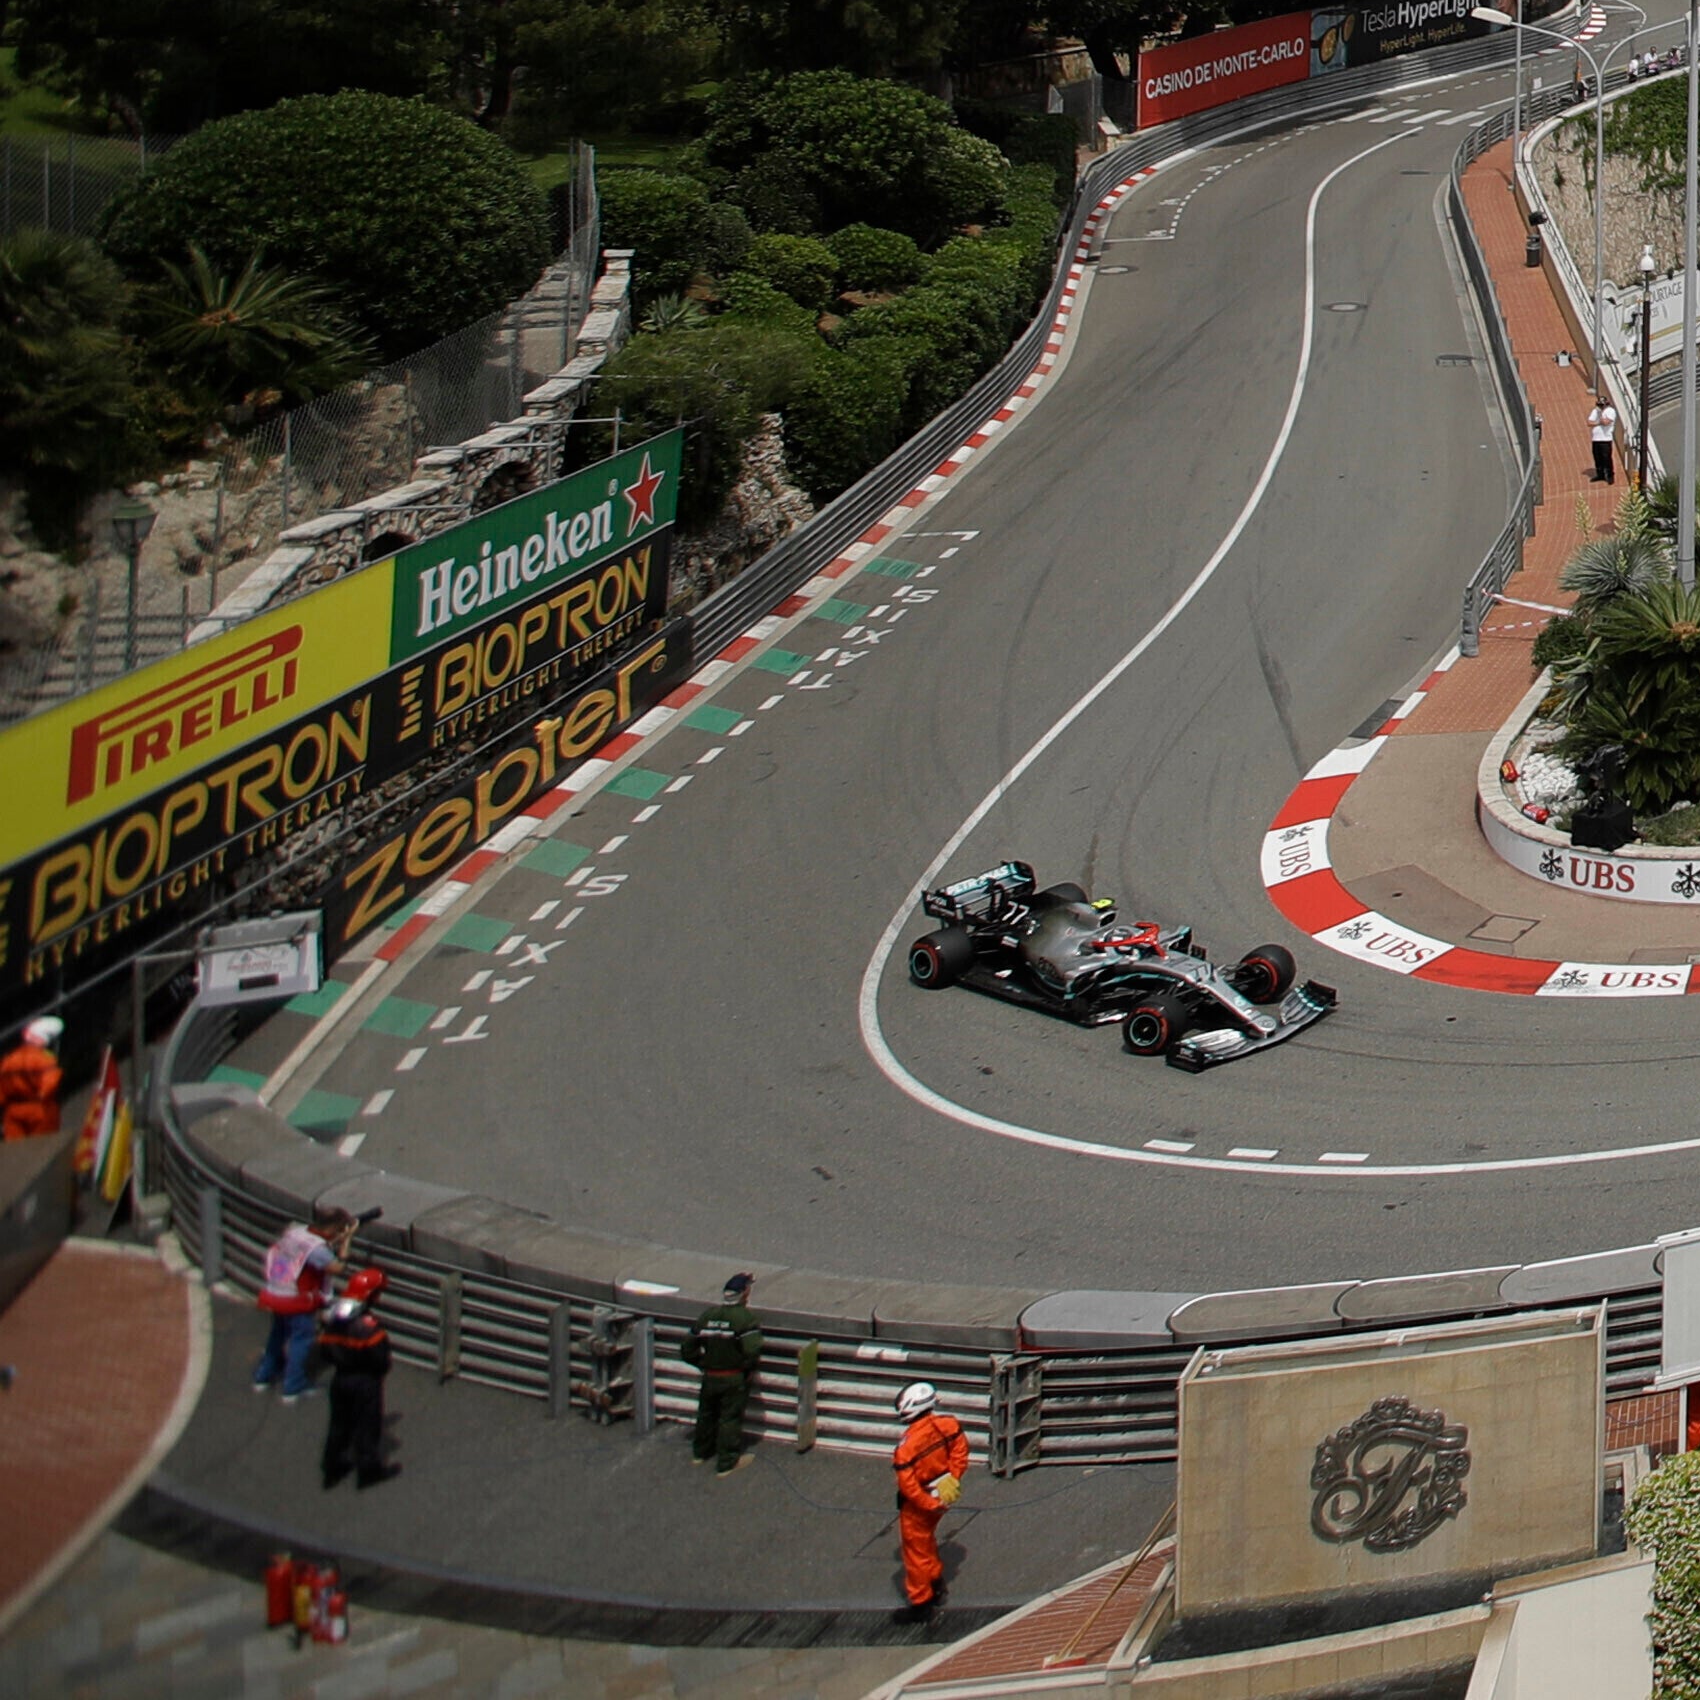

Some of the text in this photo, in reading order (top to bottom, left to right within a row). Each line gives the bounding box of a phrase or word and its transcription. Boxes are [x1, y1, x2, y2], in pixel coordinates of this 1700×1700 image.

[1144, 37, 1305, 100] CASINO DE MONTE-CARLO
[417, 499, 614, 638] Heineken
[433, 543, 652, 721] BIOPTRON
[66, 624, 304, 808] PIRELLI
[431, 610, 645, 749] HYPERLIGHT THERAPY
[29, 693, 372, 943] BIOPTRON
[344, 637, 667, 942] zepter
[1279, 839, 1312, 877] UBS
[24, 769, 367, 985] HYPERLIGHT THERAPY
[1001, 900, 1031, 926] 77
[1569, 856, 1636, 893] UBS
[1364, 932, 1435, 964] UBS
[1600, 970, 1682, 989] UBS
